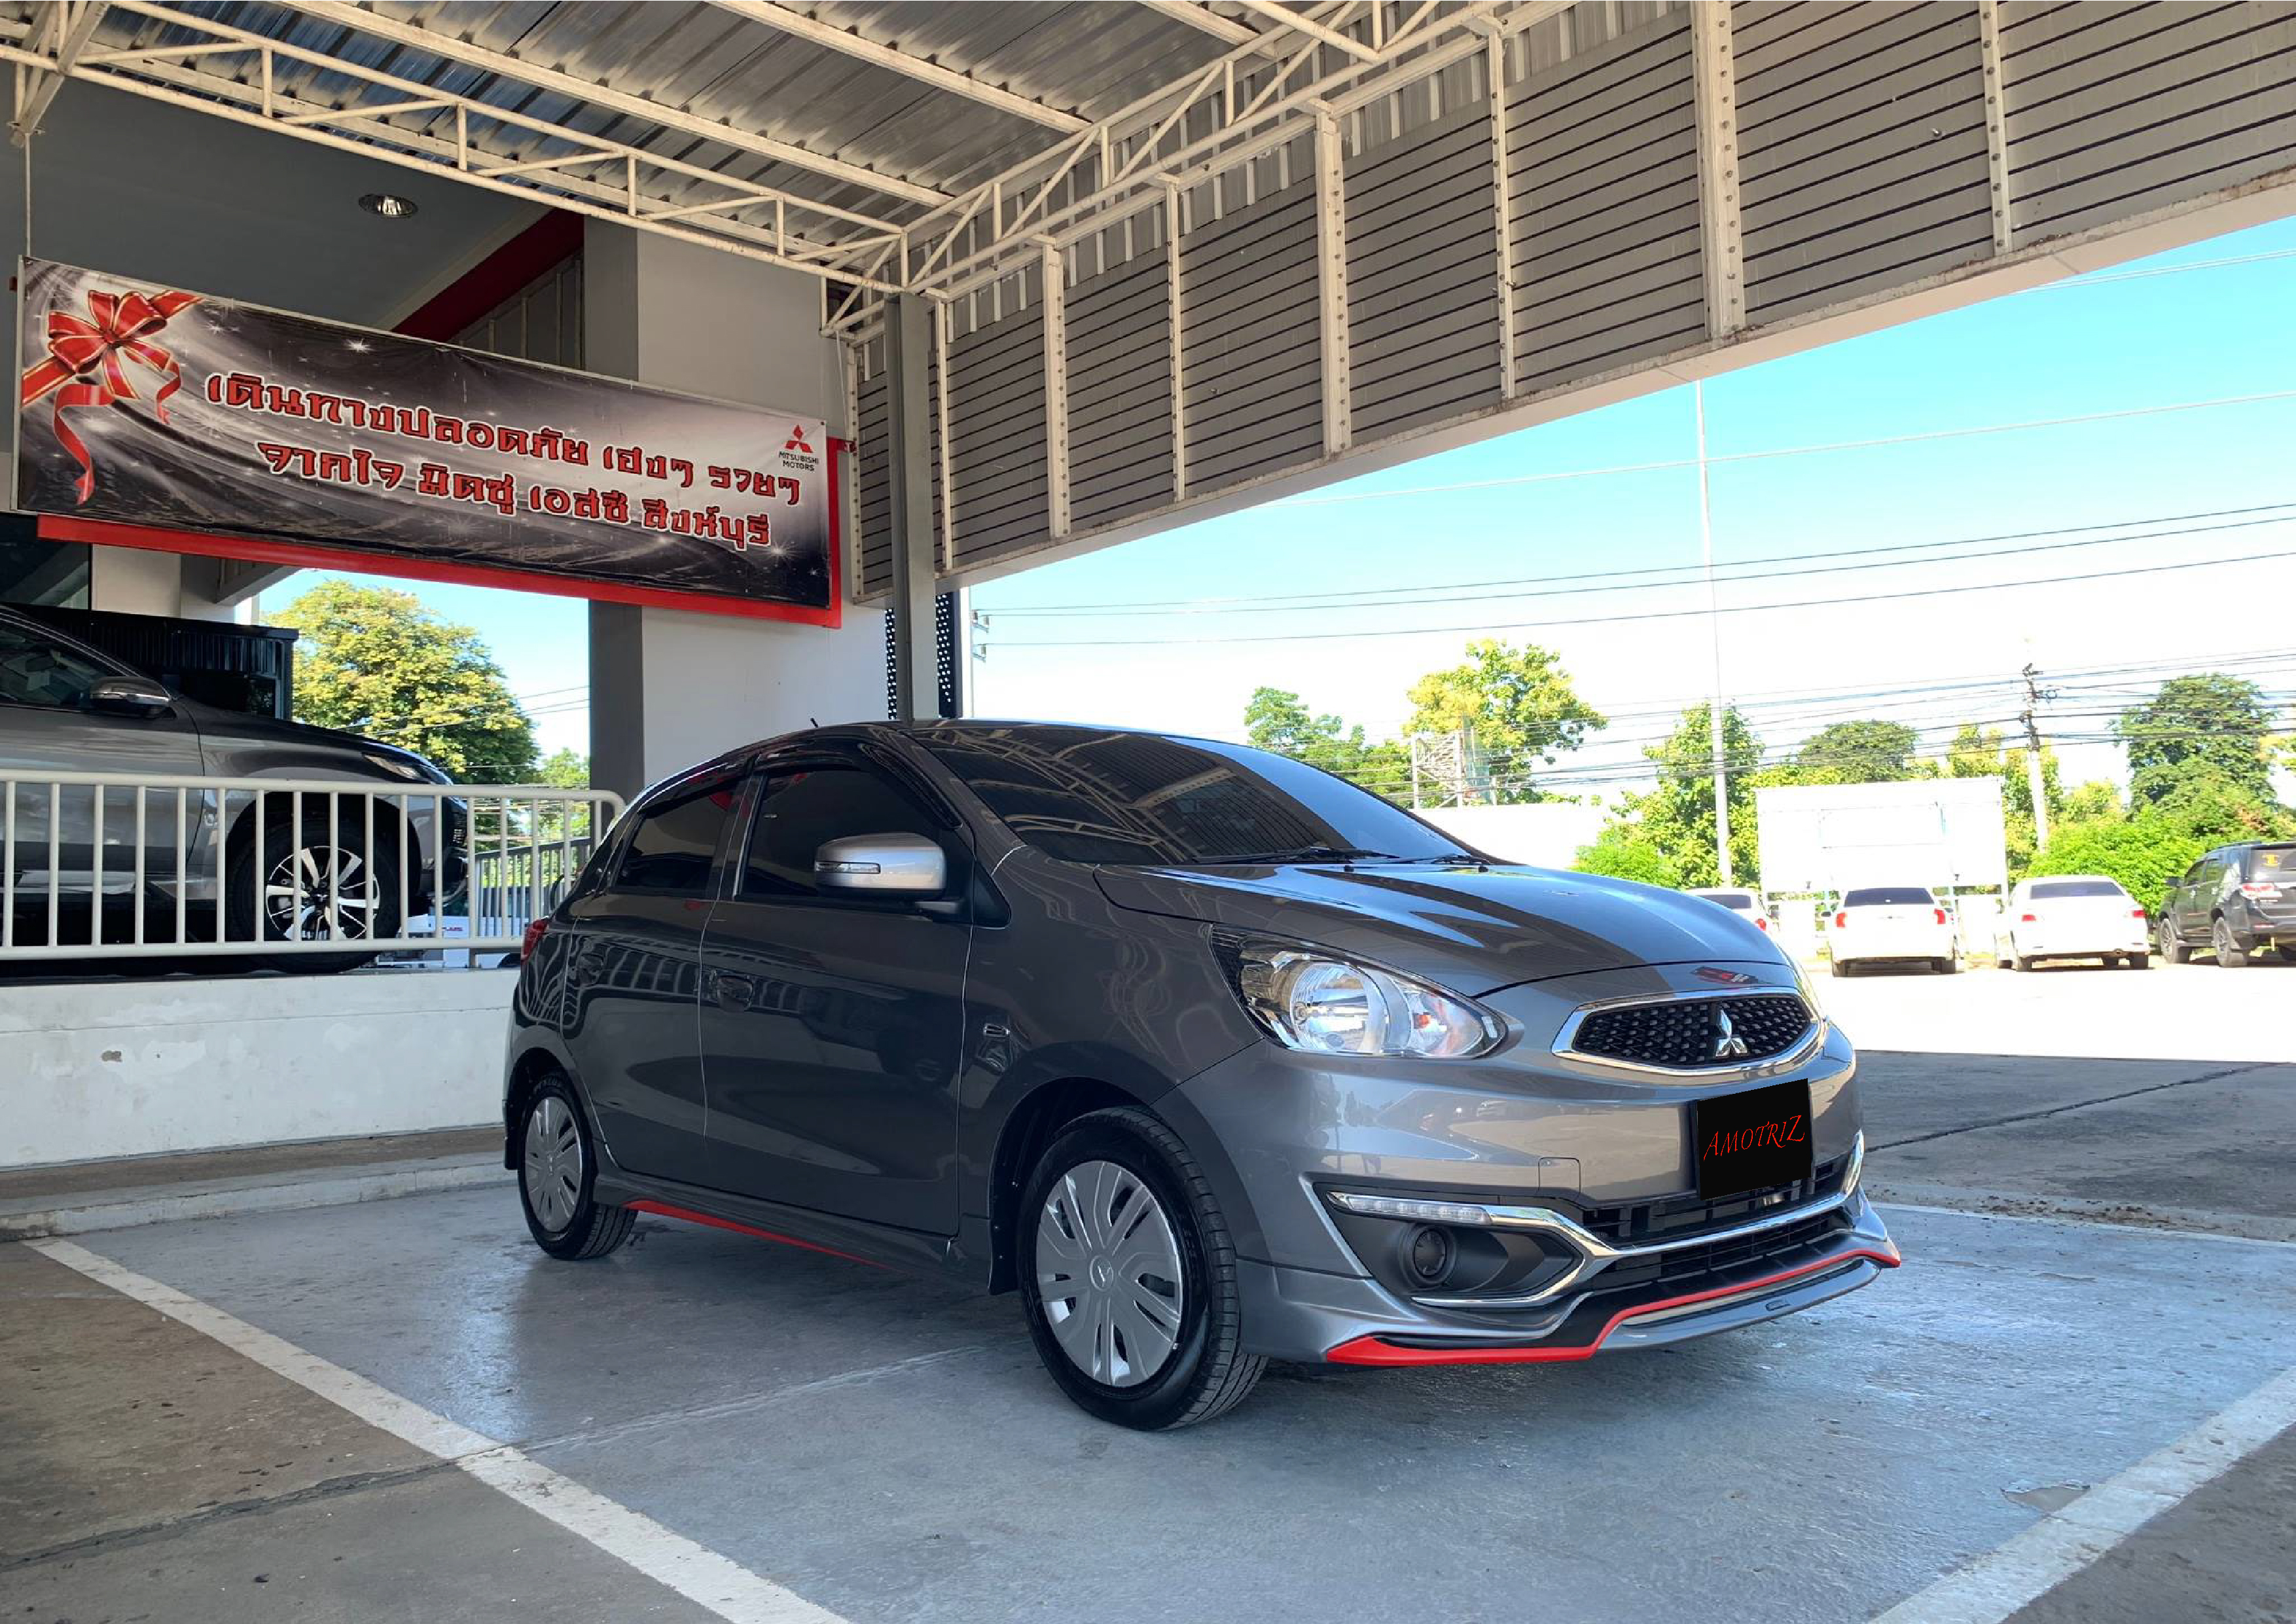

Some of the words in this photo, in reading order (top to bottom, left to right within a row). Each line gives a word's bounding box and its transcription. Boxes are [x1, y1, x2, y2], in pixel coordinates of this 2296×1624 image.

[206, 372, 588, 466] เดินทางปลอดภัย
[602, 445, 694, 488] เฮงๆ
[708, 465, 800, 506] รวยๆ
[778, 451, 819, 465] MITSUBISHI
[782, 460, 815, 472] MOTORS
[257, 442, 404, 490] จากใจ
[641, 498, 770, 549] สิงห์บุรี
